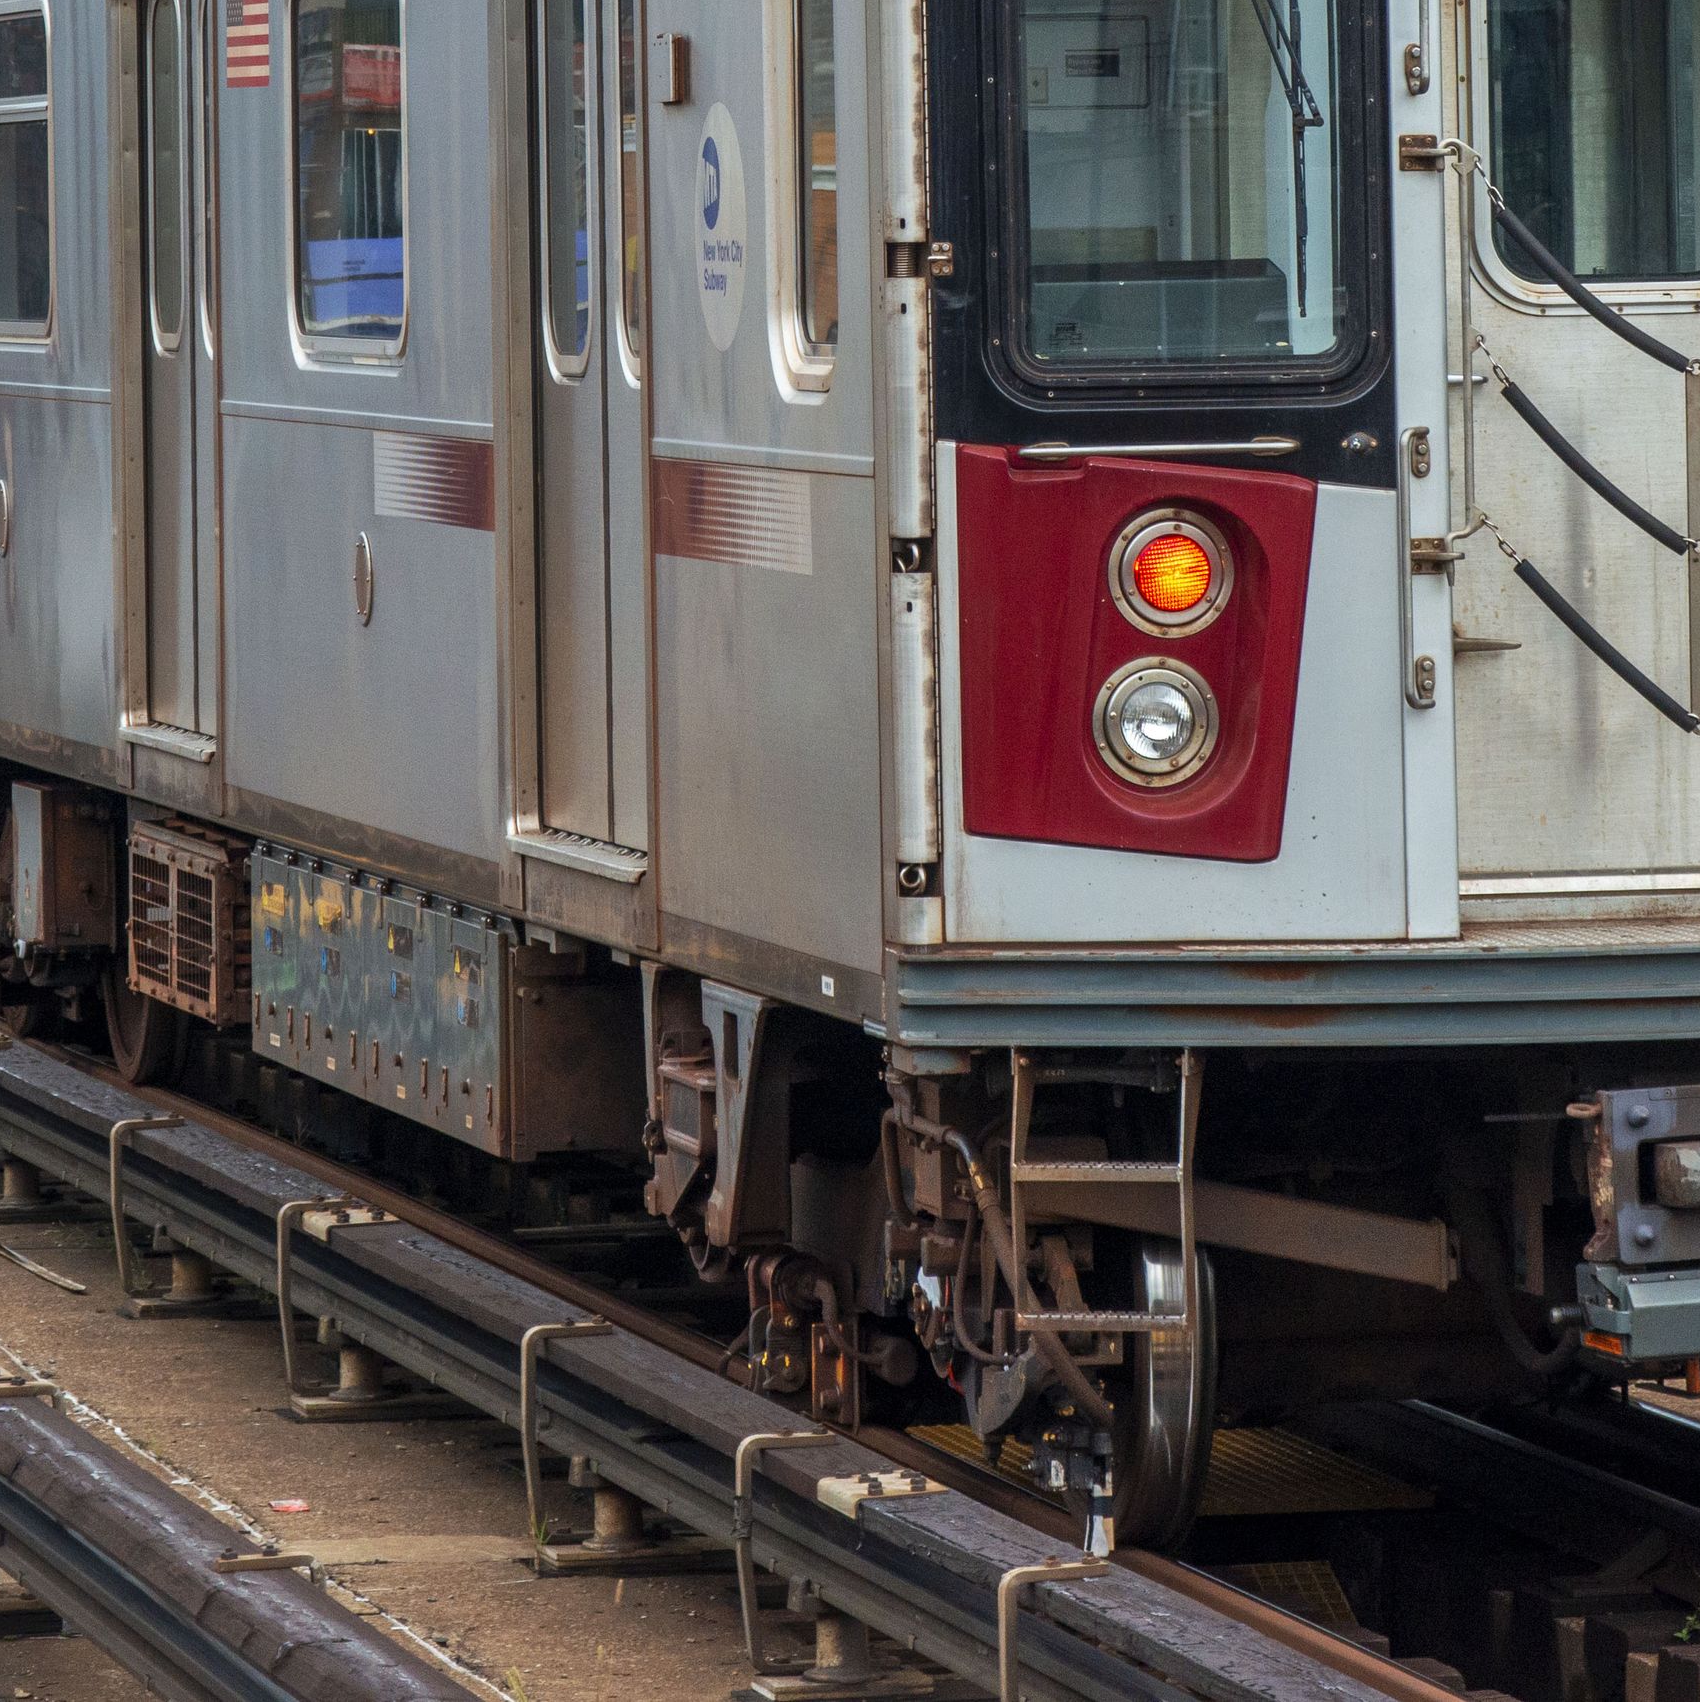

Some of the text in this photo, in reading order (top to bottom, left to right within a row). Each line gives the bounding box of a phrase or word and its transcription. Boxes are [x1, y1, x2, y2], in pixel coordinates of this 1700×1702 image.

[703, 240, 743, 267] New York City
[704, 269, 727, 295] Subway
